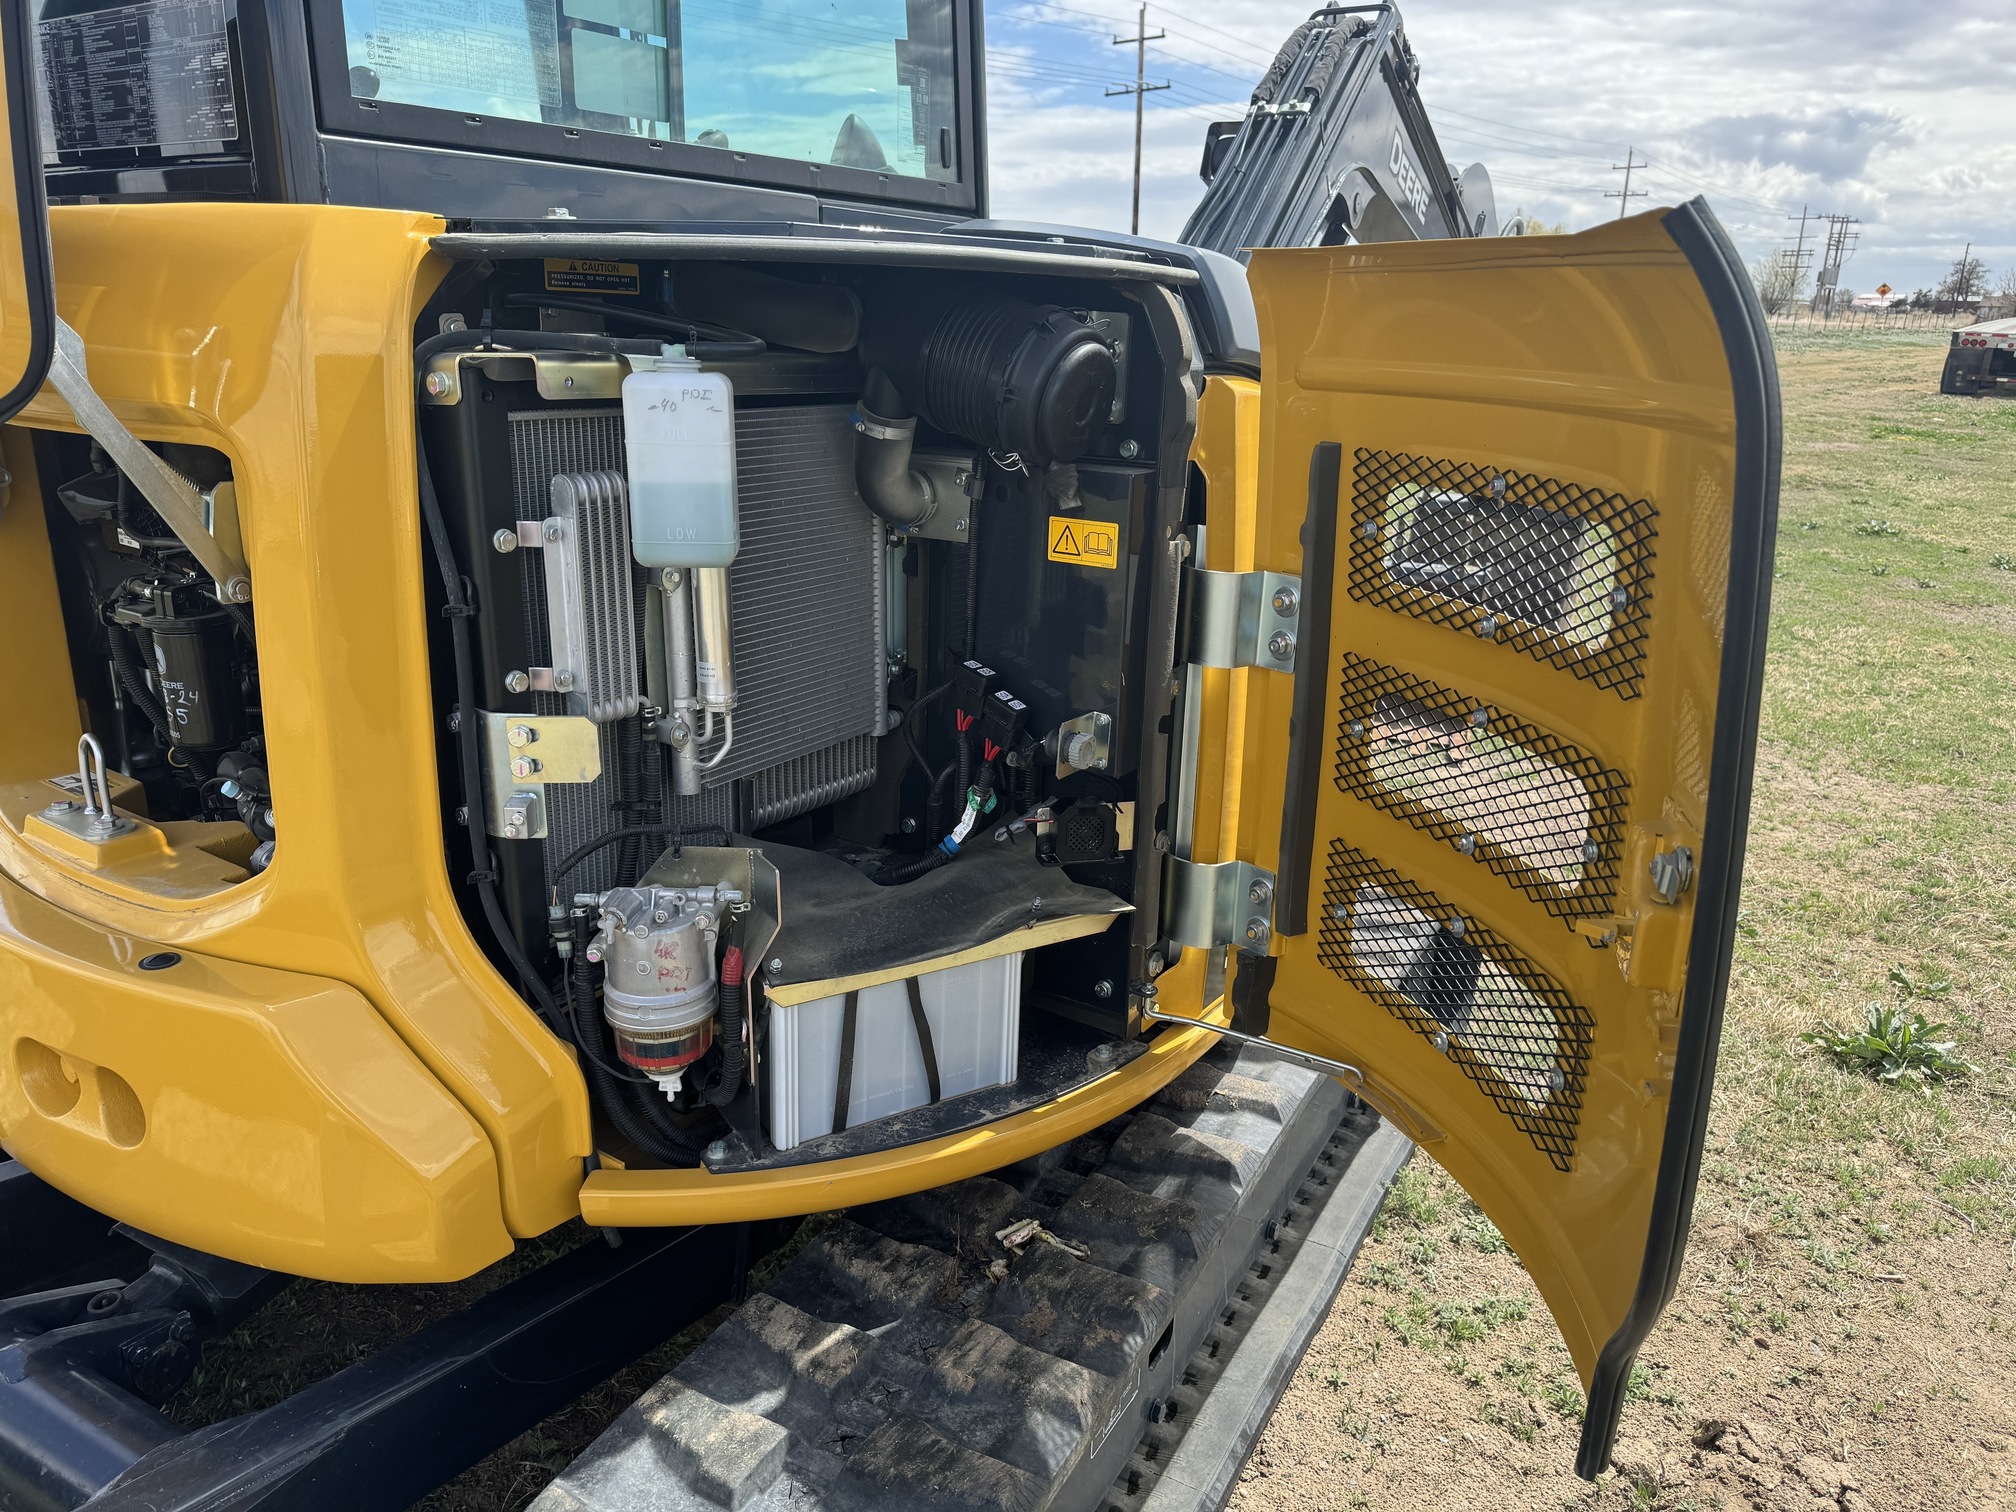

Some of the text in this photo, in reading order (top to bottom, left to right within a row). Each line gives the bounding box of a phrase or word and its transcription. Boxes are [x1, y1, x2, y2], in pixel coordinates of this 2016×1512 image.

[1388, 129, 1430, 226] DEERE
[581, 261, 620, 273] CAUTION
[660, 427, 691, 441] FULL
[667, 527, 697, 540] LOW
